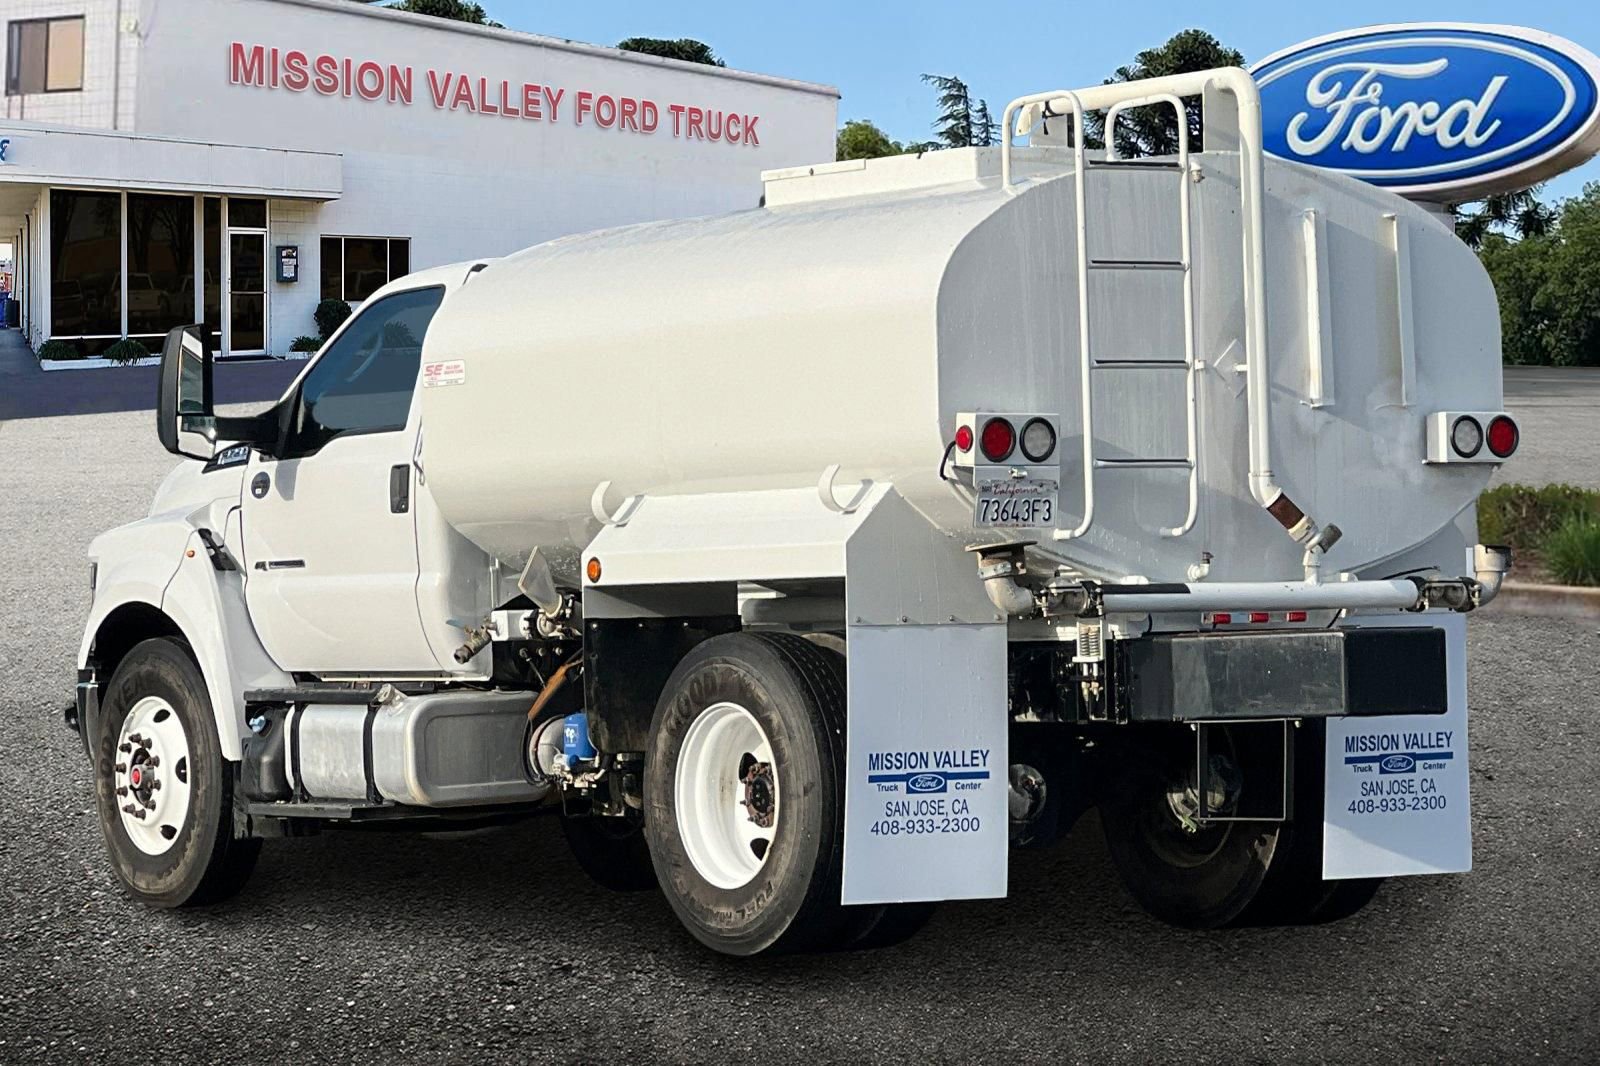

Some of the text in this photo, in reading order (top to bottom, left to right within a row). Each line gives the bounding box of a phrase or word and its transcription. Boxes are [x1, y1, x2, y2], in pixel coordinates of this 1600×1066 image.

[230, 41, 760, 146] MISSION VALLEY FORD TRUCK
[1286, 58, 1509, 156] Ford
[980, 499, 1052, 522] 73643F3
[1345, 731, 1453, 753] MISSION VALLEY
[868, 750, 990, 771] MISSION VALLEY
[1352, 762, 1446, 773] Truck Center
[1387, 757, 1407, 769] Ford
[877, 782, 981, 792] Truck Center
[915, 776, 938, 788] Ford
[1361, 778, 1436, 796] SAN JOSE, CA
[885, 798, 969, 817] SAN JOSE, CA
[1348, 795, 1446, 814] 408-933-2300
[871, 817, 980, 836] 408-933-2300
